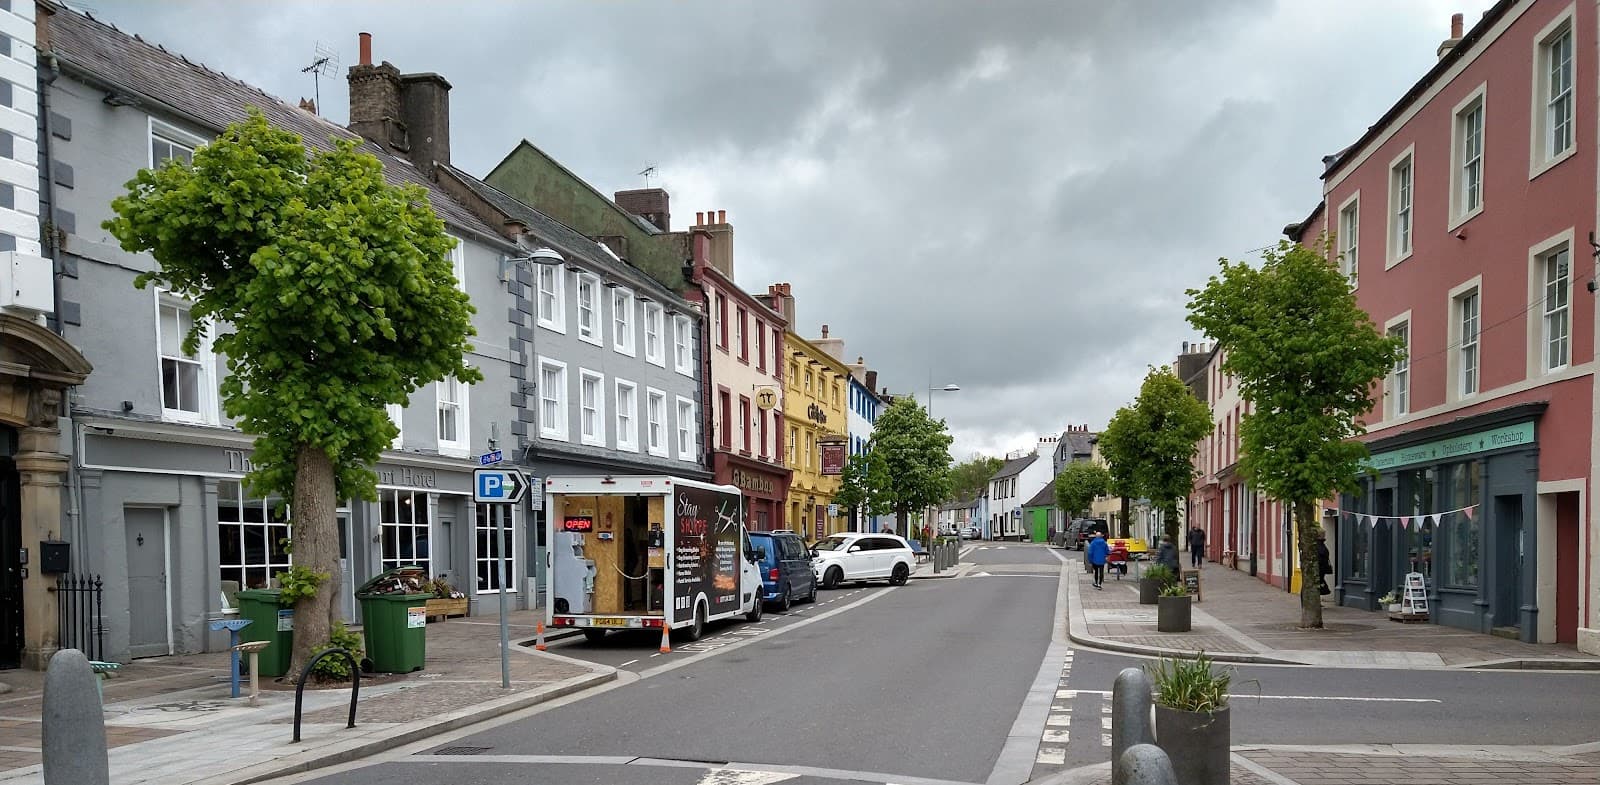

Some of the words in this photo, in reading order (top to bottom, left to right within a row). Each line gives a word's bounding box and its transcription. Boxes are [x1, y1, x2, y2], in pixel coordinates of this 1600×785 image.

[1442, 441, 1473, 456] Upholstery
[1491, 431, 1524, 447] Workshop
[400, 467, 437, 488] Hotel
[485, 476, 500, 496] P
[740, 470, 774, 494] Bamboo
[676, 491, 698, 519] Stay
[565, 519, 591, 530] OPEN
